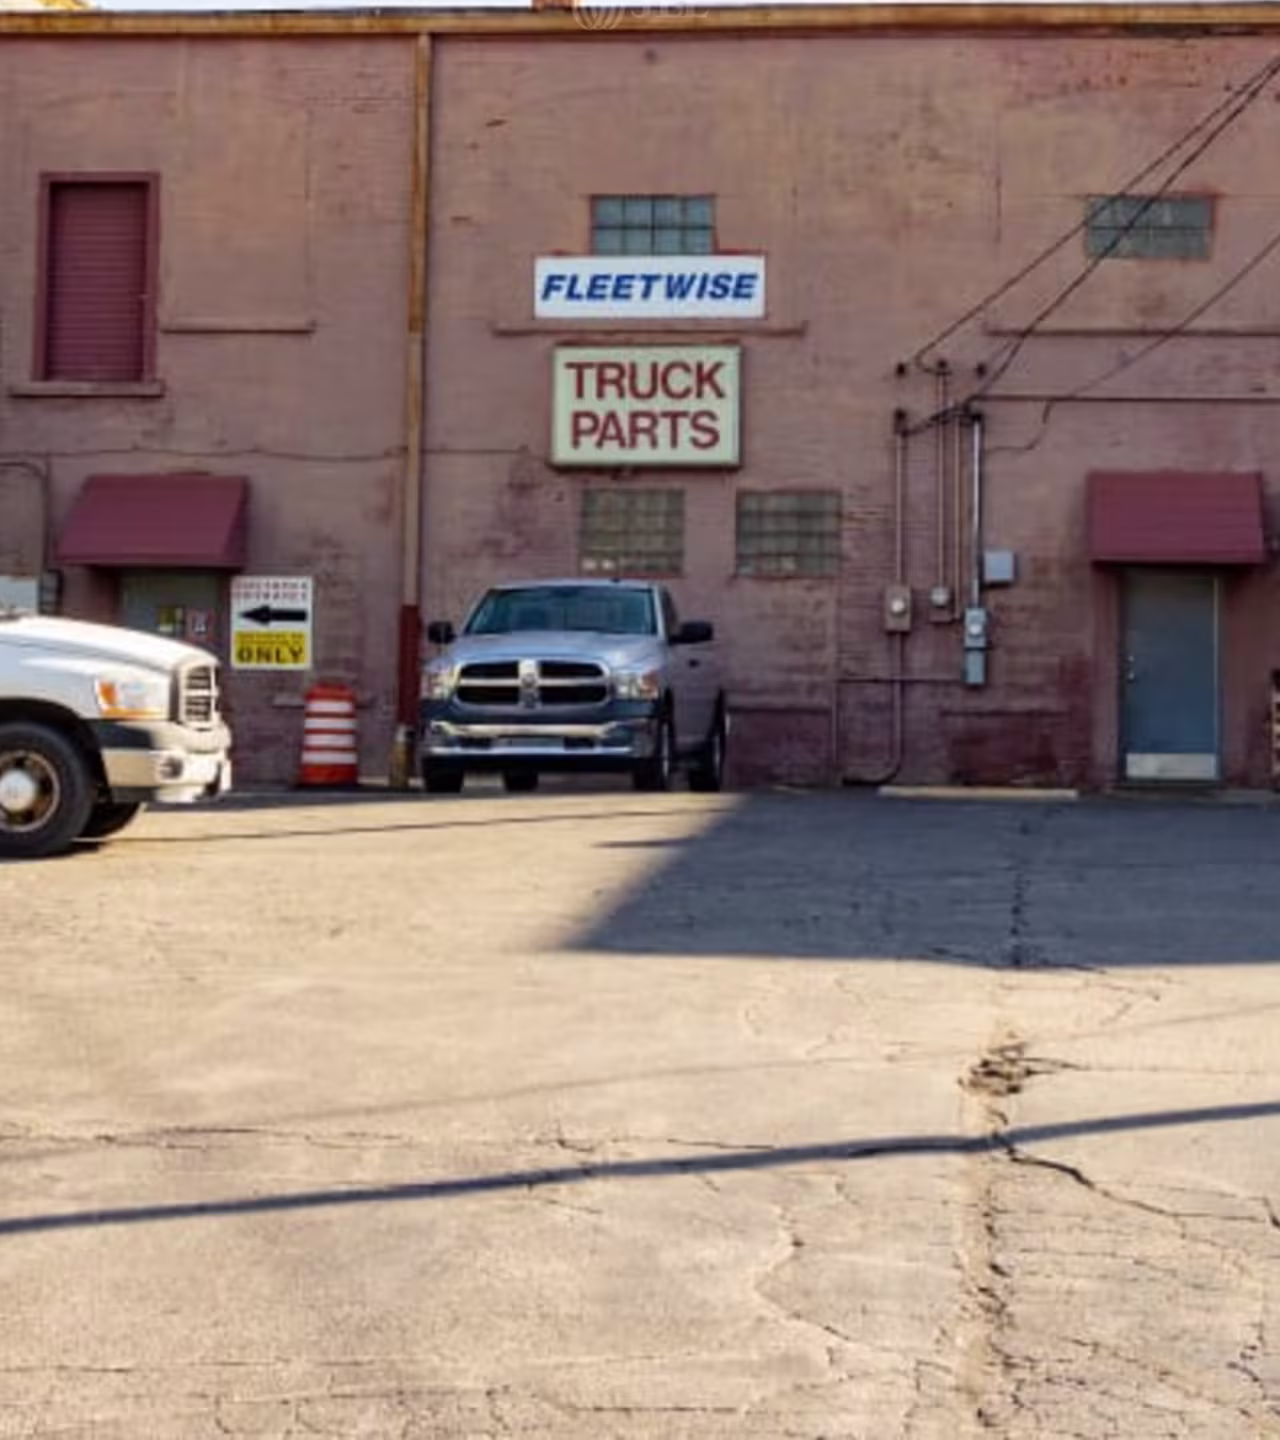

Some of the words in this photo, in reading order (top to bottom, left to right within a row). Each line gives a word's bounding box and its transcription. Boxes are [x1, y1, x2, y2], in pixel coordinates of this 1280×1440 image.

[541, 273, 758, 301] FLEETWISE
[564, 361, 726, 400] TRUCK
[570, 409, 721, 450] PARTS
[236, 646, 303, 664] ONLY
